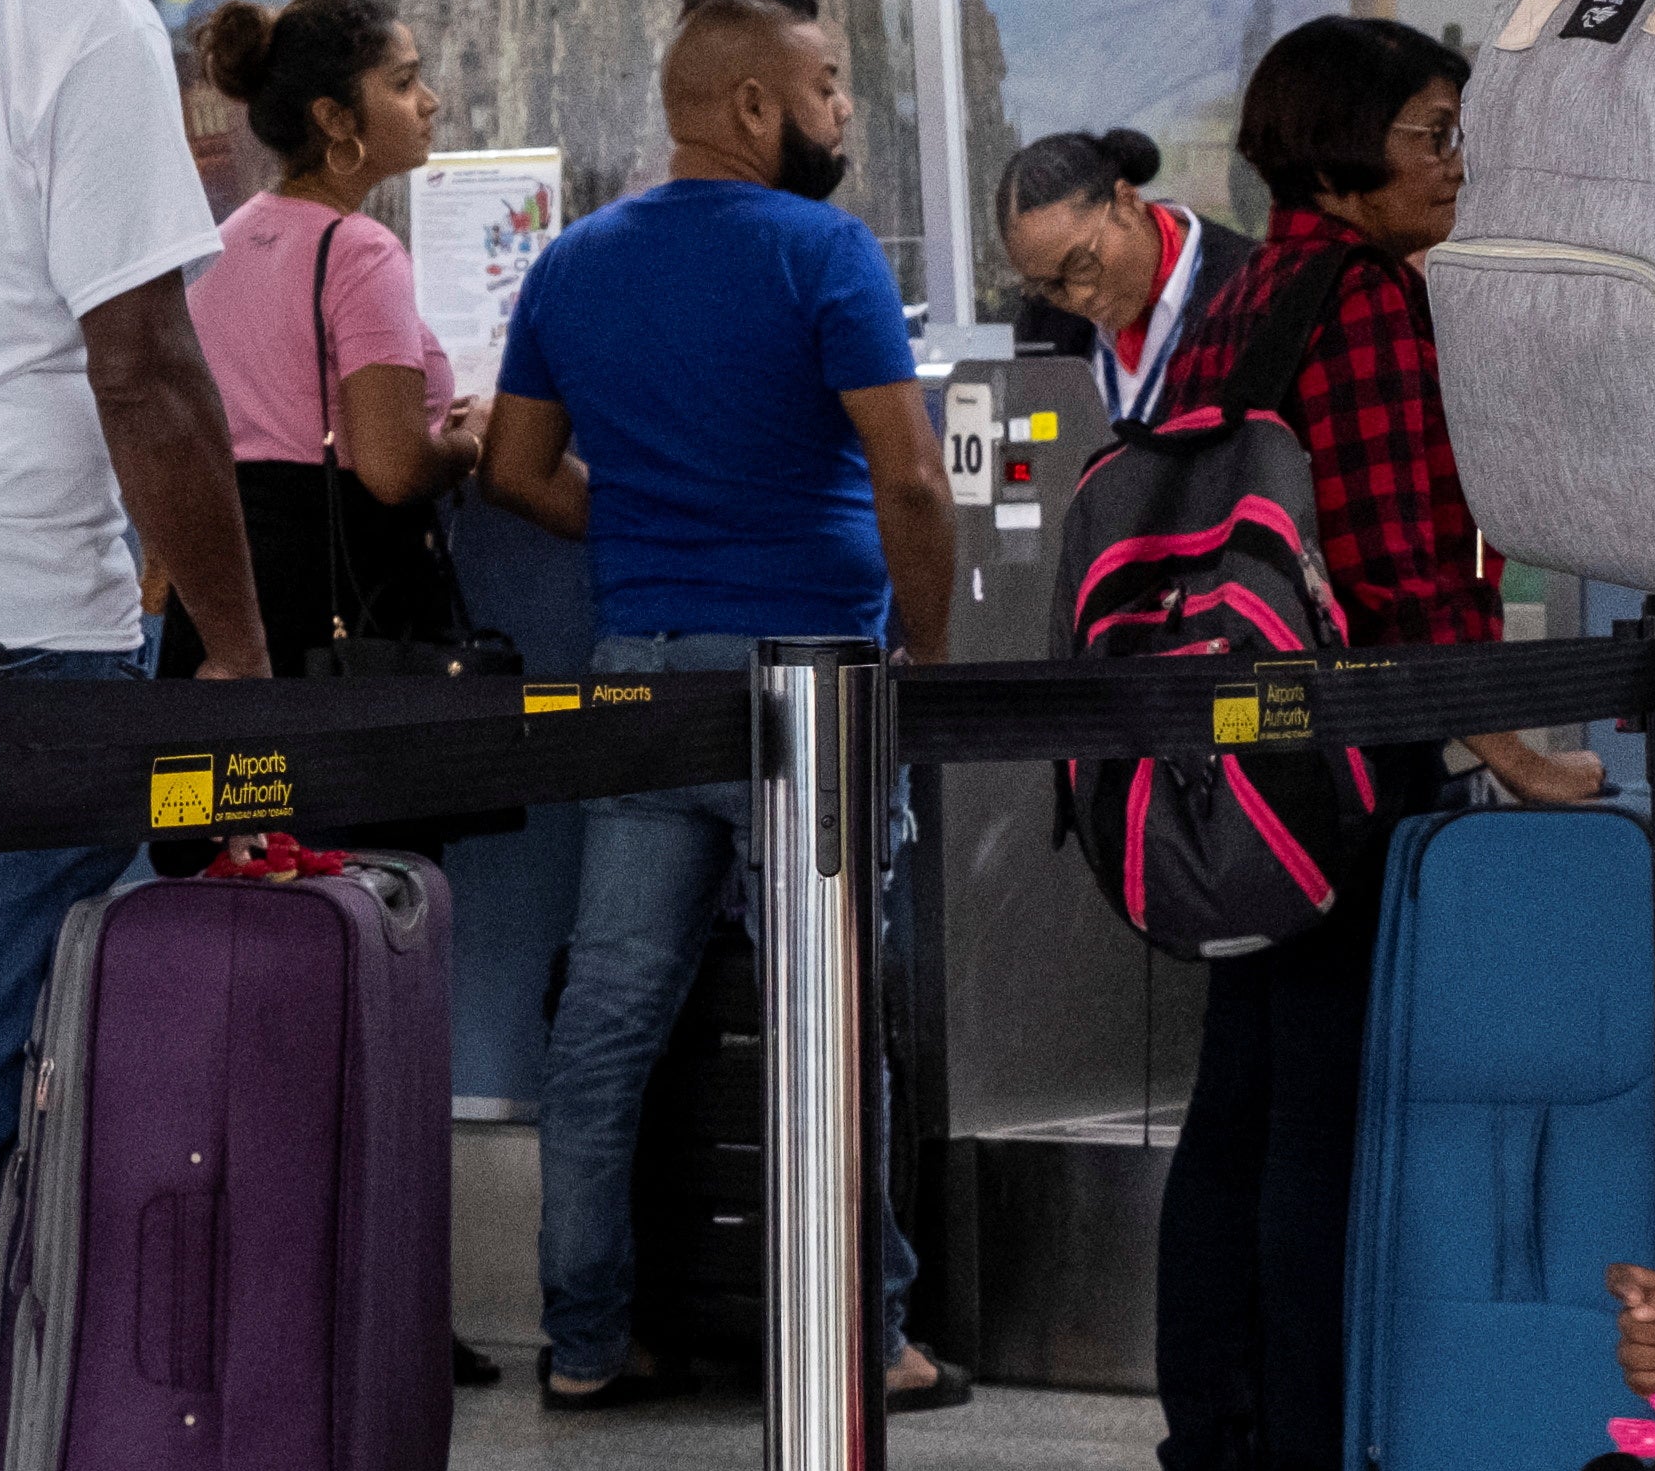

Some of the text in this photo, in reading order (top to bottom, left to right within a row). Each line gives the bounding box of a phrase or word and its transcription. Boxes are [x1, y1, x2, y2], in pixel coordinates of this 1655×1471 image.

[951, 432, 983, 476] 10
[592, 684, 653, 705] Airports
[226, 749, 287, 780] Airports
[219, 779, 293, 808] Authority
